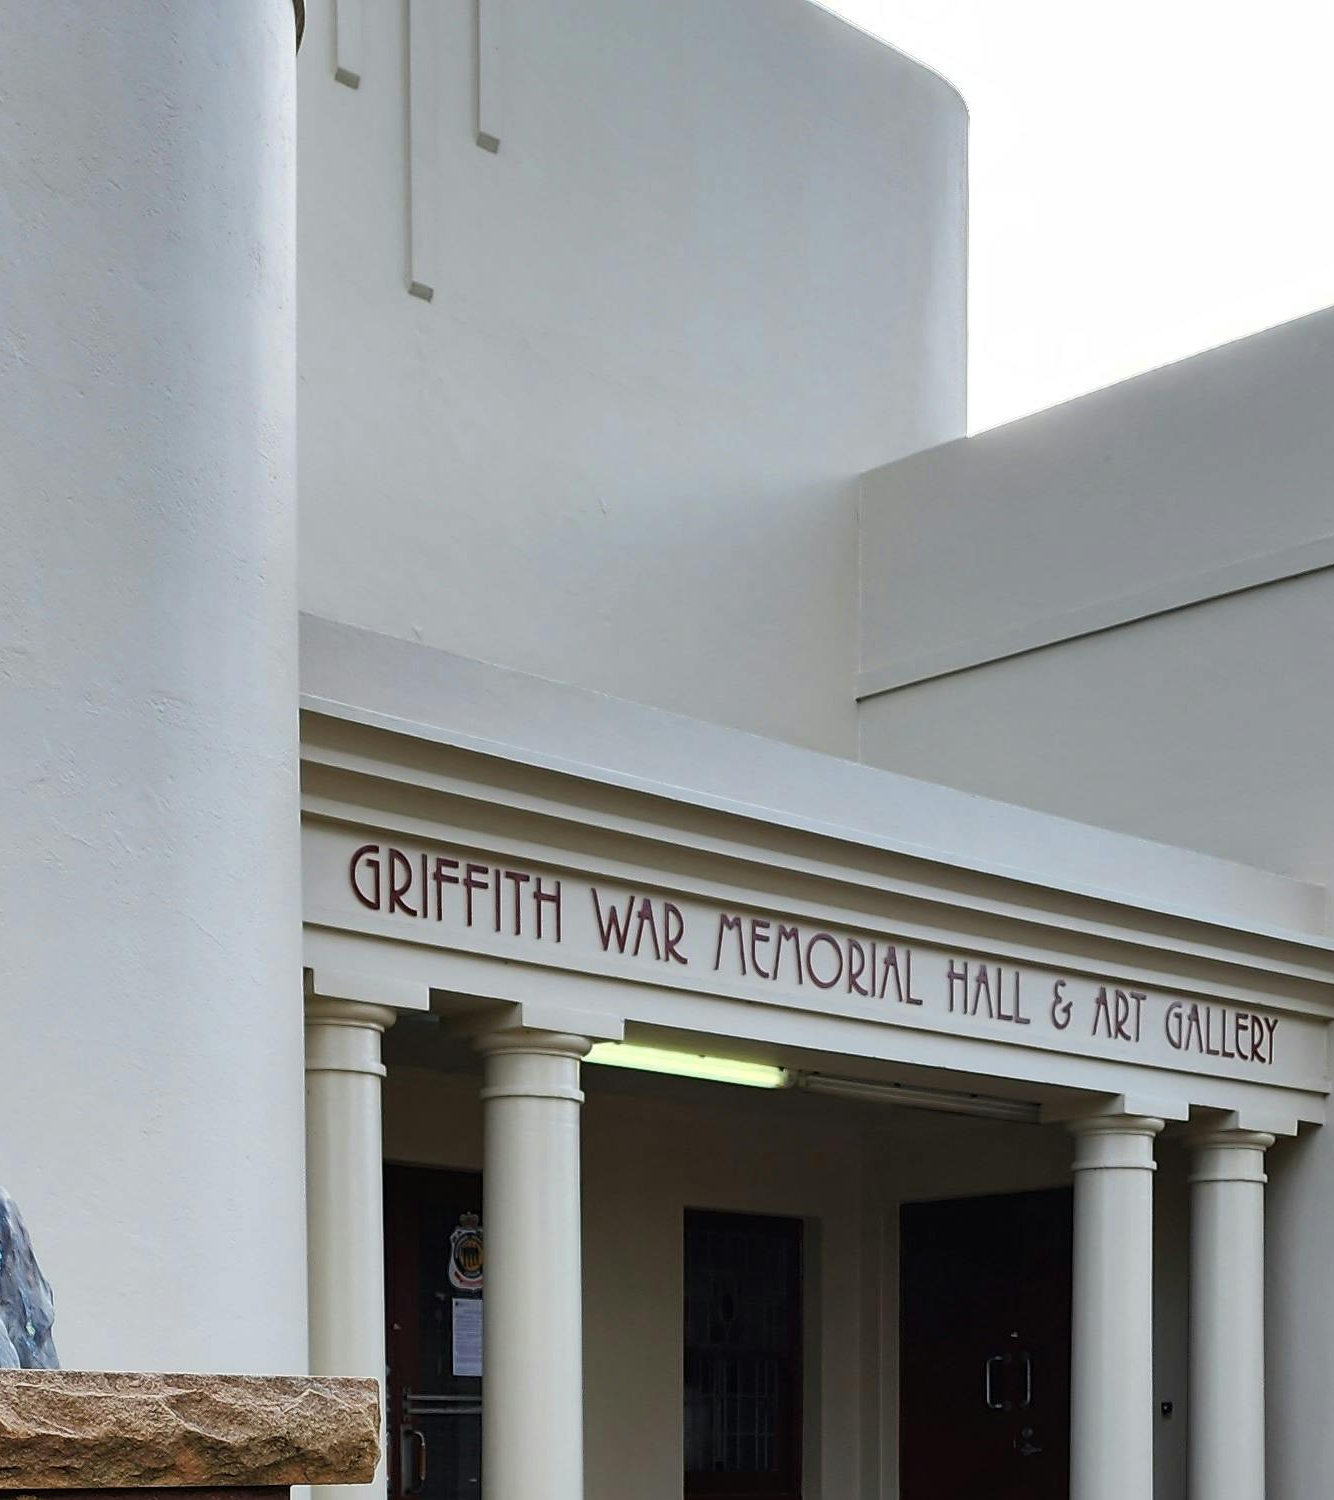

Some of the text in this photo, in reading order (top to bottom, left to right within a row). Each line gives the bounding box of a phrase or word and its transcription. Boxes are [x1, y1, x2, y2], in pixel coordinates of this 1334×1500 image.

[350, 845, 1279, 1065] GRIFFITH WAR MEMORIAL HALL & ART GALLERY
